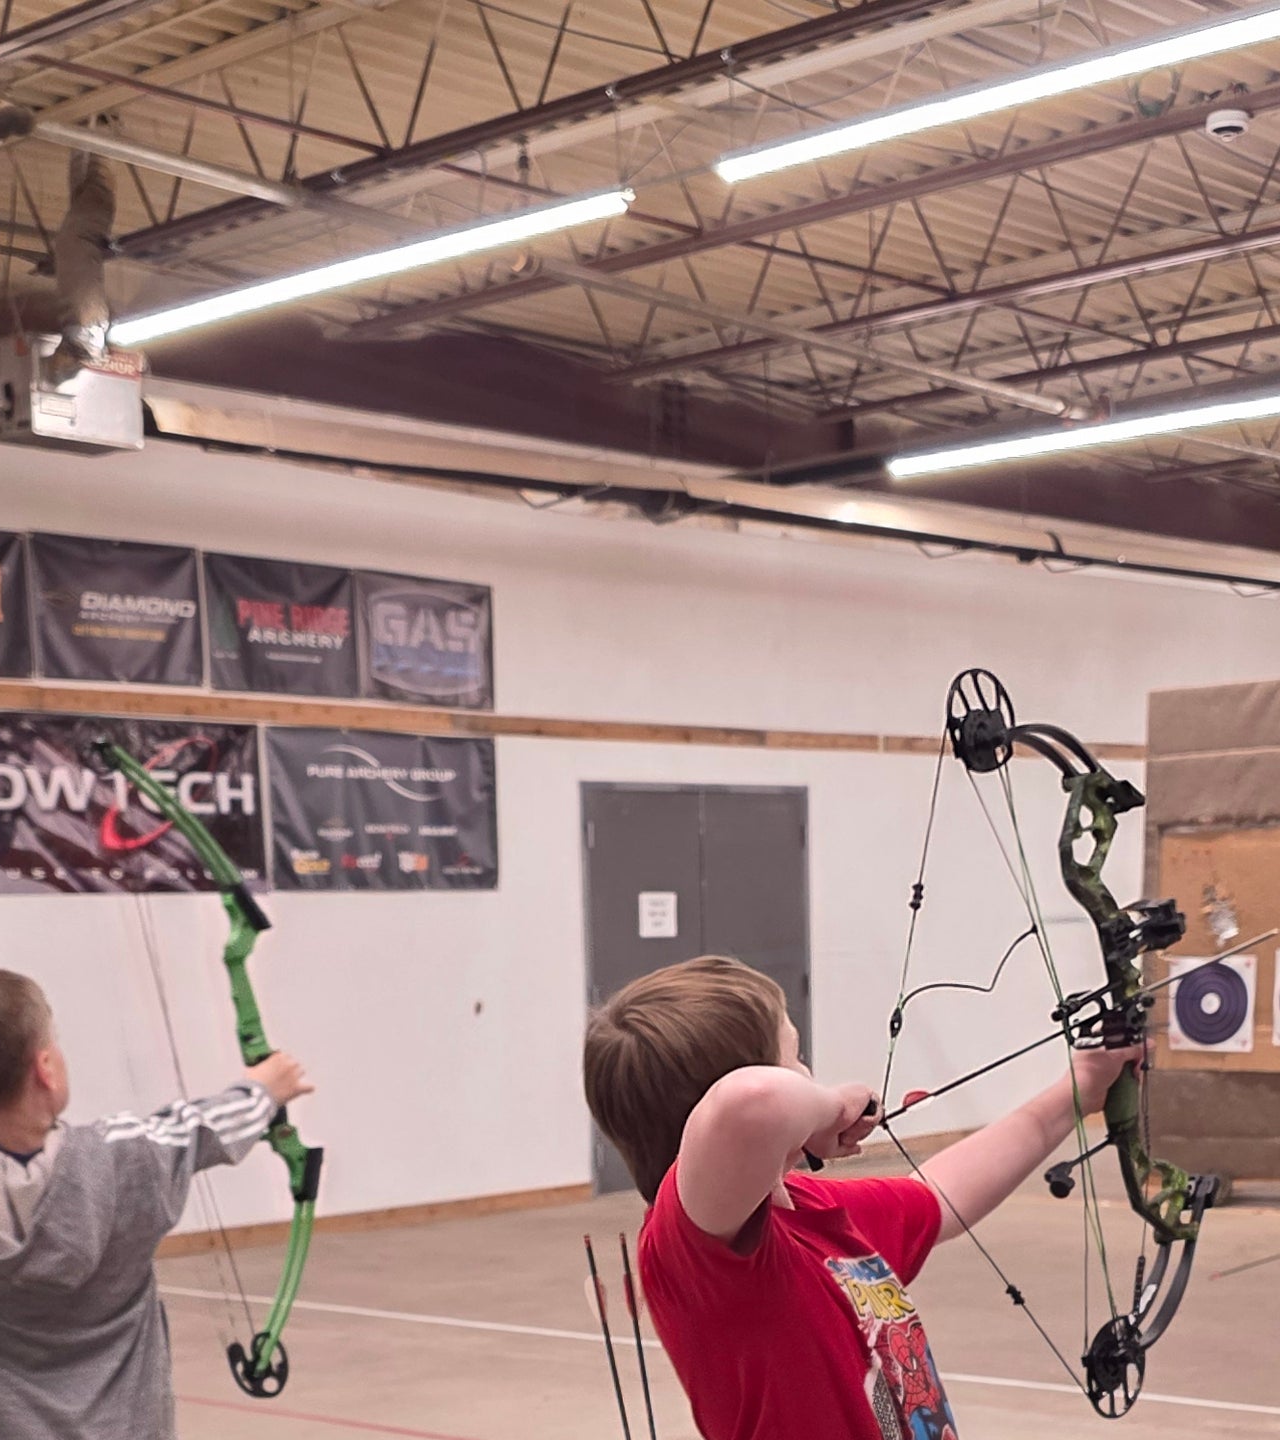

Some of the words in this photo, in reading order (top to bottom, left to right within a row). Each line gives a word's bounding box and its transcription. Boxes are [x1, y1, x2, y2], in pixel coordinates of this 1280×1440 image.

[80, 591, 196, 618] DIAMOND
[236, 597, 285, 629] PINE
[247, 625, 344, 650] ARCHERY
[372, 602, 479, 654] GAS
